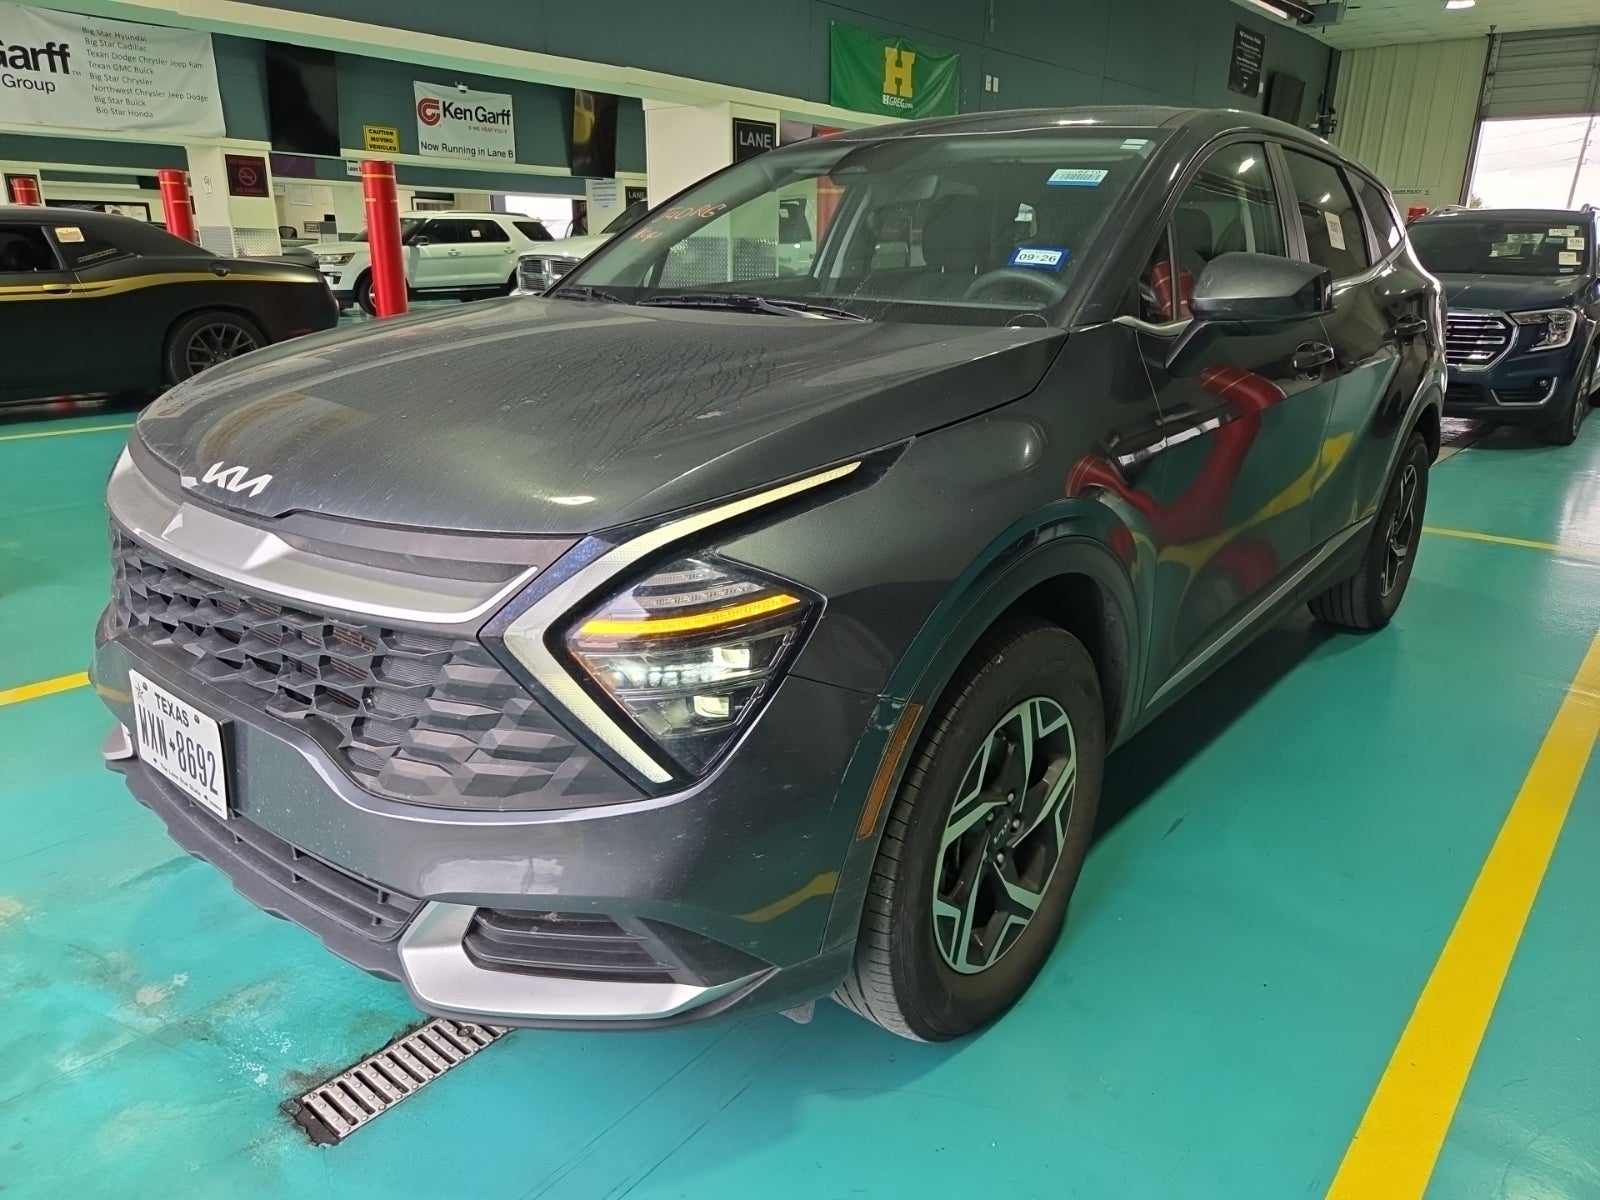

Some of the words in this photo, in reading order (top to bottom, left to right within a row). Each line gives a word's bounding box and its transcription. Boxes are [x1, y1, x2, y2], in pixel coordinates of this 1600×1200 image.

[82, 27, 95, 36] Big
[97, 30, 112, 38] Star
[115, 32, 147, 42] Hyundai
[85, 37, 97, 47] Big
[100, 40, 115, 48] Star
[118, 42, 147, 52] Cadillac
[87, 49, 109, 59] Texan
[112, 52, 137, 63] Dodge
[139, 56, 168, 66] Chrysler
[170, 59, 187, 69] Jeep
[188, 60, 204, 69] Ram
[88, 61, 111, 71] Texan
[113, 63, 132, 73] GMC
[134, 66, 154, 75] Buick
[883, 46, 915, 98] H
[1, 73, 56, 94] Group
[90, 72, 102, 82] Big
[104, 74, 120, 83] Star
[122, 75, 153, 86] Chrysler
[92, 84, 133, 95] Northwest
[135, 88, 165, 98] Chrysler
[169, 91, 184, 100] Jeep
[186, 92, 209, 102] Dodge
[94, 95, 107, 105] Big
[108, 97, 124, 105] Star
[125, 98, 146, 107] Buick
[111, 108, 126, 116] Star
[128, 108, 154, 118] Honda
[442, 100, 473, 122] Ken
[475, 106, 511, 126] Garff
[739, 130, 771, 149] LANE
[421, 141, 439, 152] Now
[441, 143, 476, 157] Running
[478, 146, 485, 156] in
[488, 147, 506, 158] Lane
[508, 149, 514, 158] B
[628, 190, 646, 199] LANE
[201, 461, 273, 498] KIA
[155, 692, 190, 728] TEXAS
